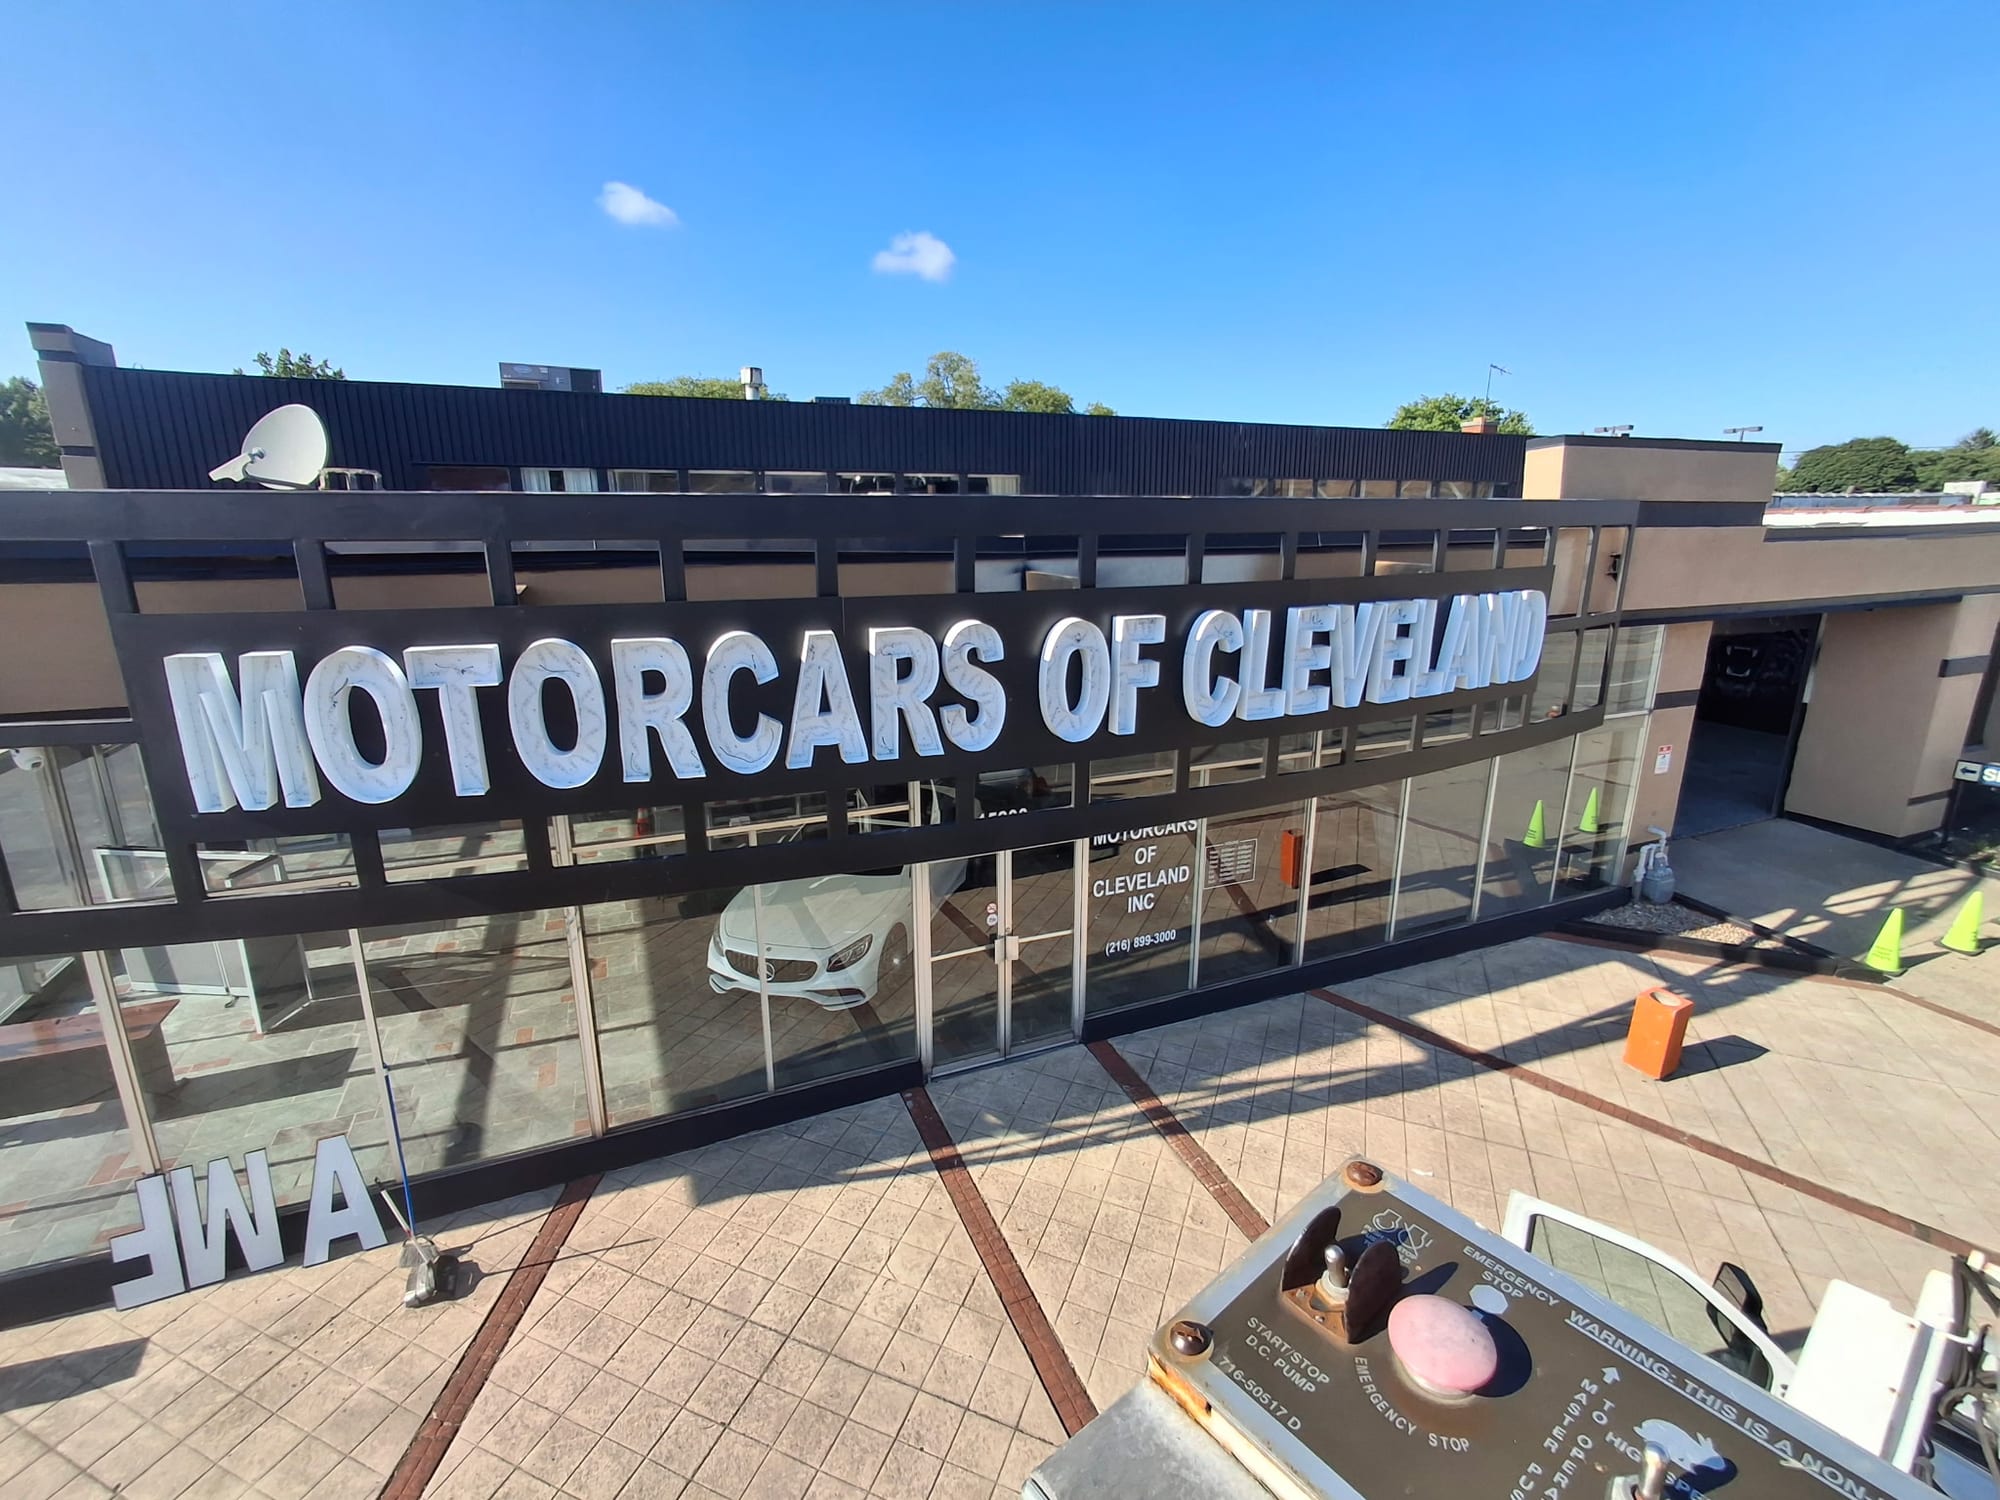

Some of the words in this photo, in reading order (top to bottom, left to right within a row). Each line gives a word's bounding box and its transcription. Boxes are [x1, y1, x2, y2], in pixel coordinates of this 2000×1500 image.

[163, 619, 1007, 813] MOTORCARS
[1039, 614, 1166, 743] OF
[1183, 589, 1547, 727] CLEVELAND
[1093, 865, 1190, 898] CLEVELAND
[1134, 845, 1158, 865] OF
[1127, 893, 1155, 914] INC
[1105, 939, 1132, 957] (216)
[1133, 928, 1177, 949] 899-3000
[1462, 1245, 1561, 1307] EMERGENCY
[1481, 1270, 1525, 1300] STOP
[1244, 1334, 1271, 1362] D.C.
[1273, 1356, 1317, 1394] PUMP
[1247, 1316, 1331, 1385] START/STOP
[1218, 1355, 1289, 1417] 716-50517
[1286, 1416, 1302, 1431] D
[1353, 1355, 1417, 1436] EMERGENCY
[1428, 1432, 1470, 1453] STOP
[1542, 1377, 1599, 1454] MASTER
[1568, 1309, 1678, 1384] WARNING:
[1683, 1378, 1739, 1422] THIS
[1743, 1416, 1770, 1440] IS
[1774, 1438, 1795, 1458] A
[1800, 1451, 1886, 1500] NON-
[1541, 1434, 1593, 1500] OPERA
[1604, 1430, 1643, 1463] HIG
